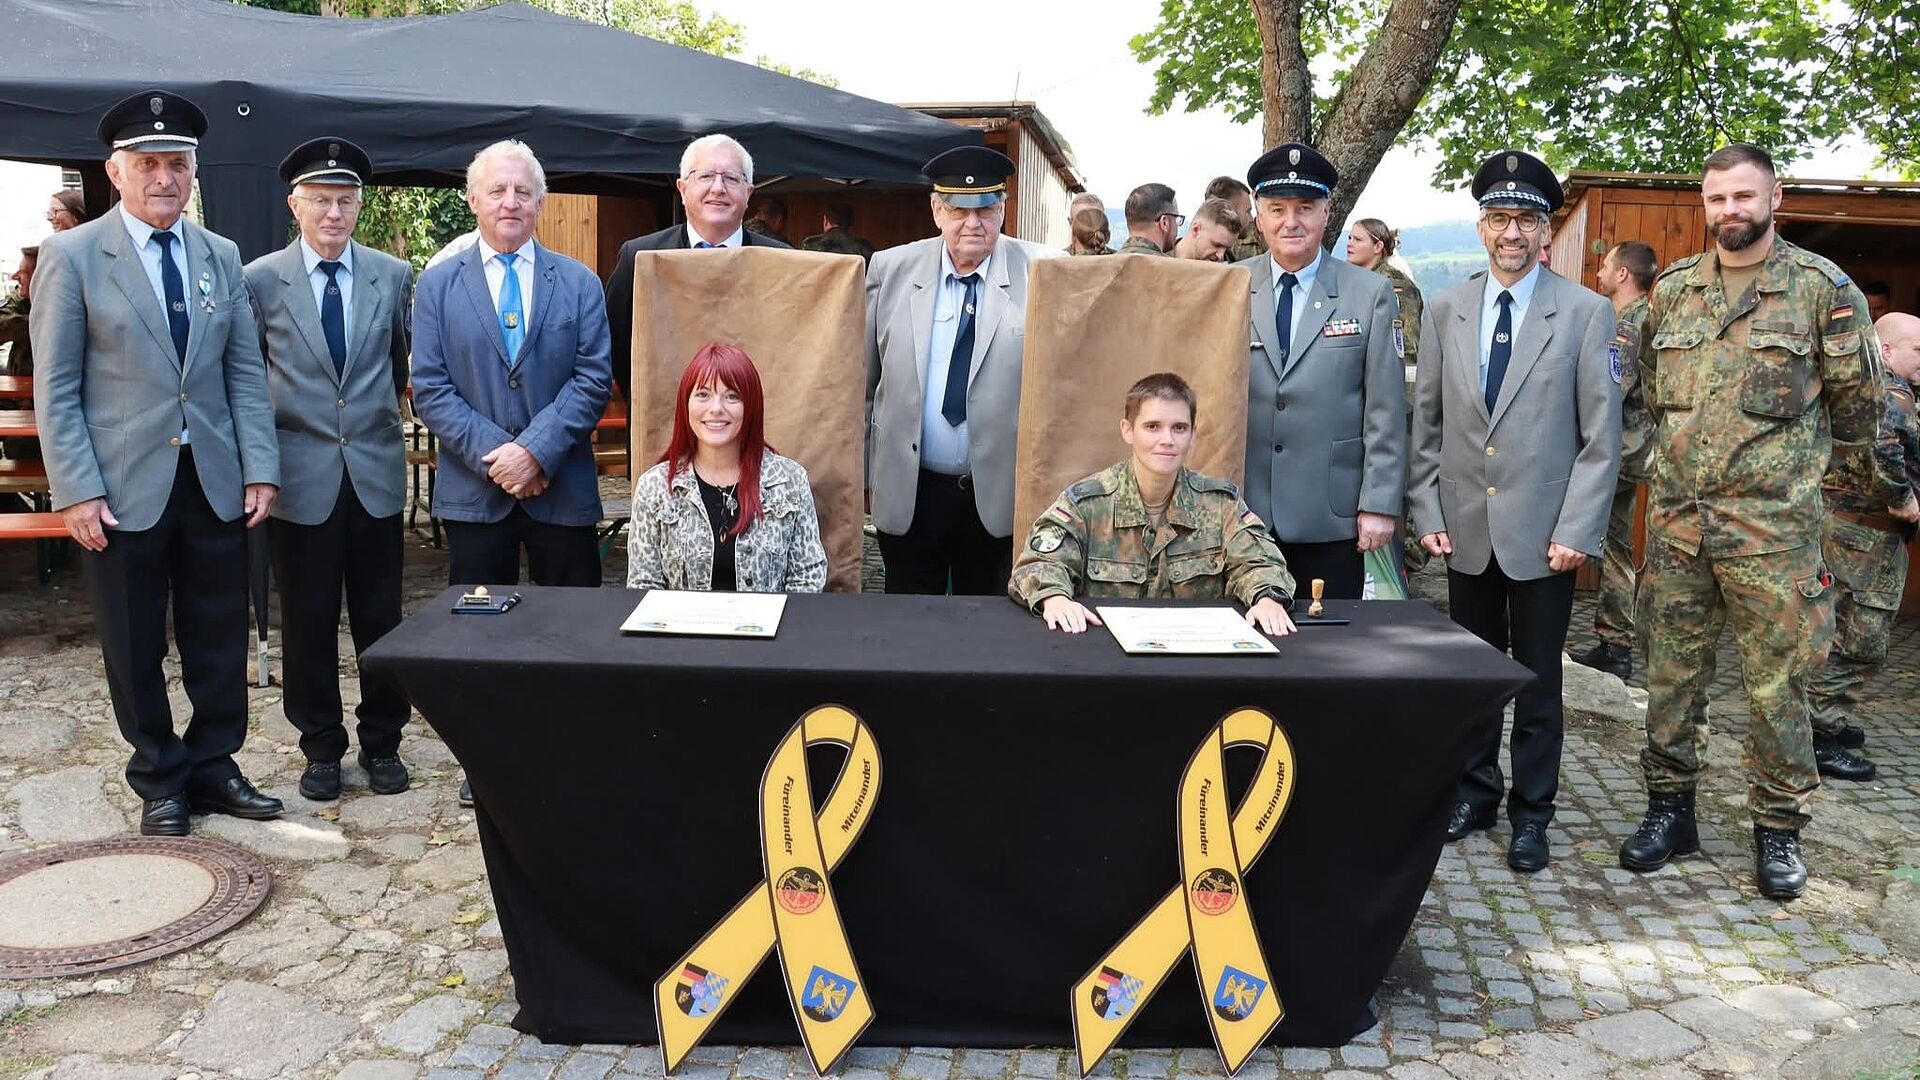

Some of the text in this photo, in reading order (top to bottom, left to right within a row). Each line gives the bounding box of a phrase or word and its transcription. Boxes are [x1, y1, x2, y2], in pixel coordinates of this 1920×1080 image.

[782, 775, 795, 856] Füreinander
[841, 758, 871, 833] Miteinander
[1199, 777, 1212, 857] Füreinander
[1255, 760, 1285, 834] Miteinander
